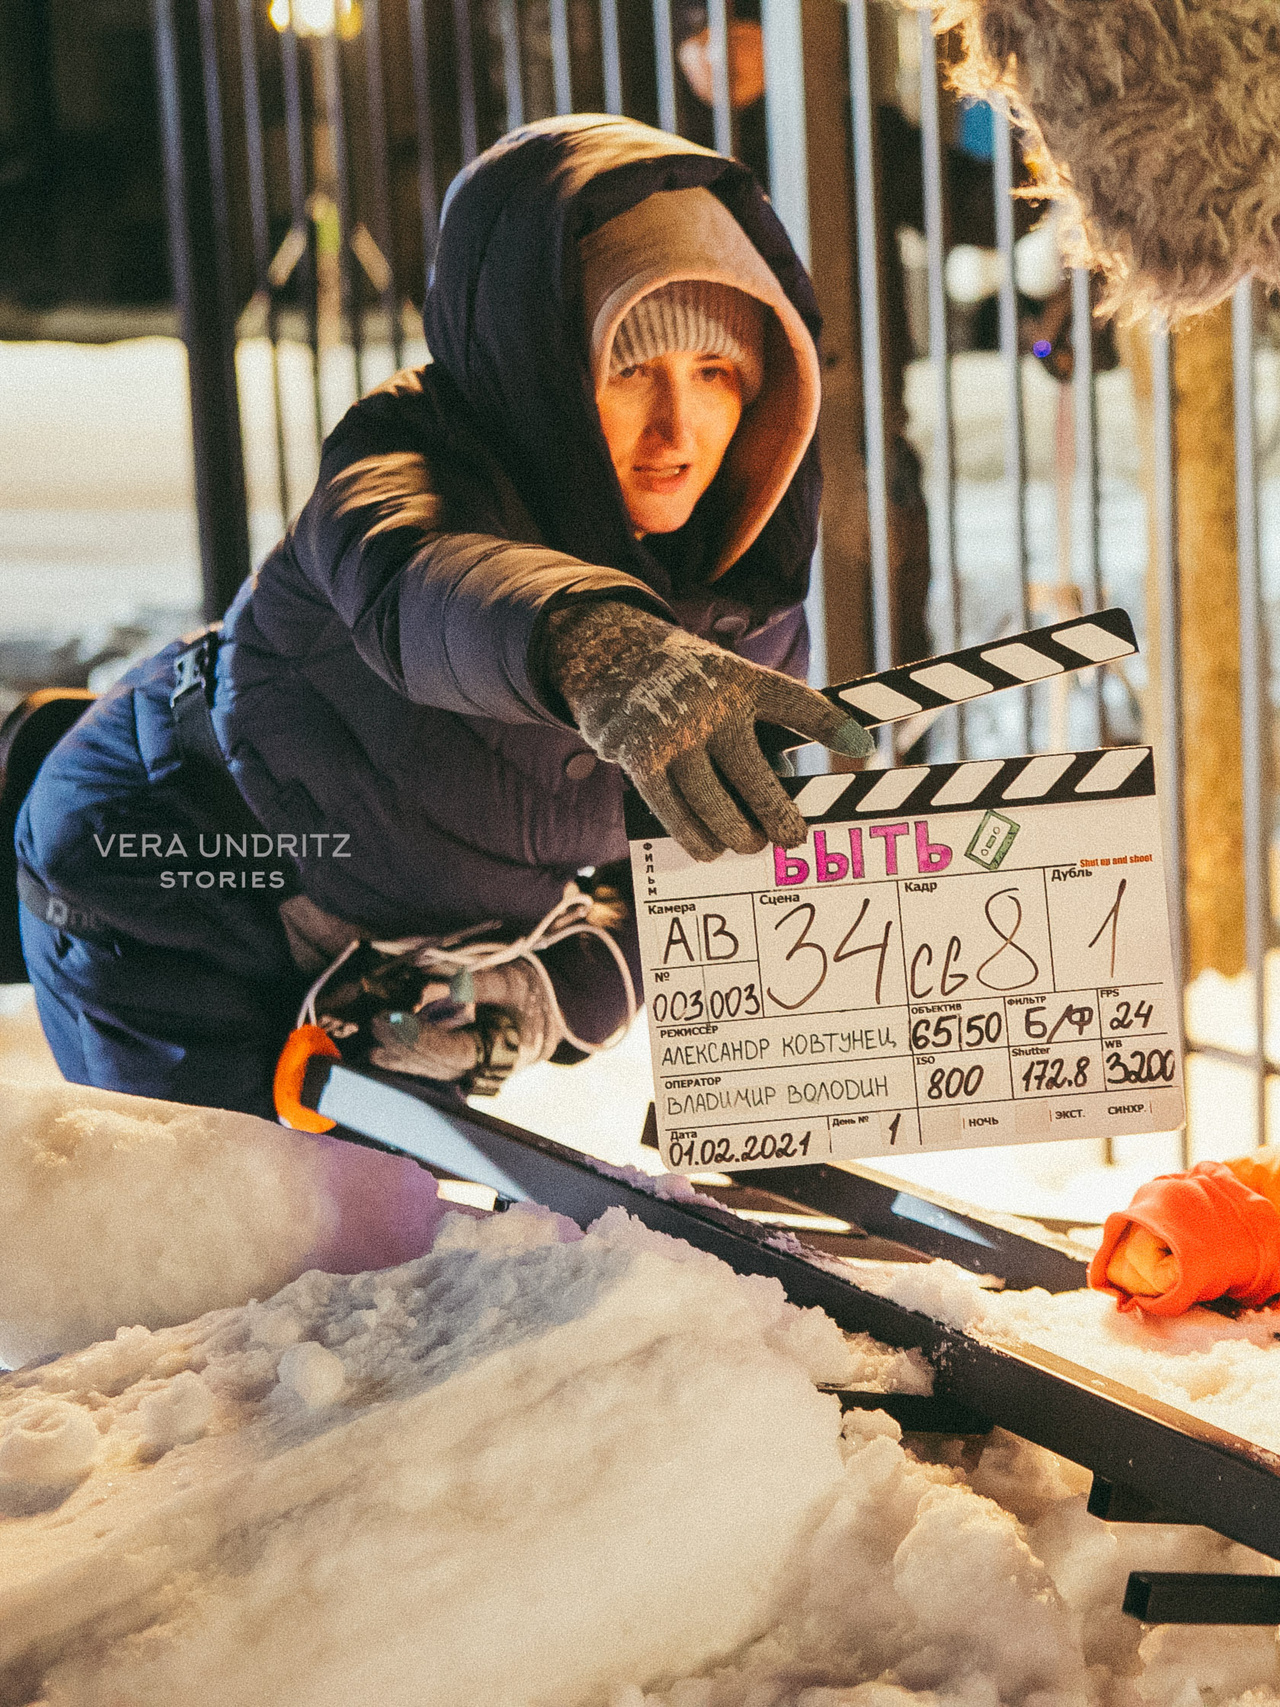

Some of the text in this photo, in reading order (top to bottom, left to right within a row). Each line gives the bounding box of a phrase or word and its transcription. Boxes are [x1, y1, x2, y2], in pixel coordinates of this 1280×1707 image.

[1079, 858, 1099, 868] Shut
[1112, 855, 1128, 865] and
[1129, 854, 1153, 864] shoot
[1051, 868, 1093, 882] Дубль
[904, 880, 938, 893] Кадр
[759, 892, 801, 906] Сцена
[648, 902, 697, 915] Камера
[1088, 878, 1127, 978] 1
[766, 898, 893, 1010] 34
[1100, 988, 1120, 998] FPS
[652, 983, 761, 1022] 003 003
[1007, 996, 1047, 1007] ФИЛЬТР
[911, 1003, 963, 1015] ОБЪЕКТИВ
[1109, 1000, 1153, 1031] 24
[662, 1026, 897, 1067] АЛЕКСАНДР КОВТУНЕЦ
[1011, 1046, 1051, 1057] Shutter
[1105, 1040, 1122, 1049] WB
[916, 1055, 936, 1066] ISO
[1105, 1049, 1176, 1084] 3200
[1022, 1056, 1090, 1092] 172.8
[664, 1076, 721, 1090] ОПЕРАТОР
[927, 1065, 984, 1100] 800
[667, 1075, 889, 1115] ВЛАДИМИР ВОЛОДИН
[1055, 1109, 1086, 1120] ЭКСТ.
[1107, 1104, 1147, 1115] СИНХР.
[832, 1118, 856, 1128] День
[968, 1116, 999, 1127] НОЧЬ
[670, 1130, 698, 1142] Дата
[888, 1112, 902, 1146] 1
[669, 1131, 812, 1167] 01.02.2021
